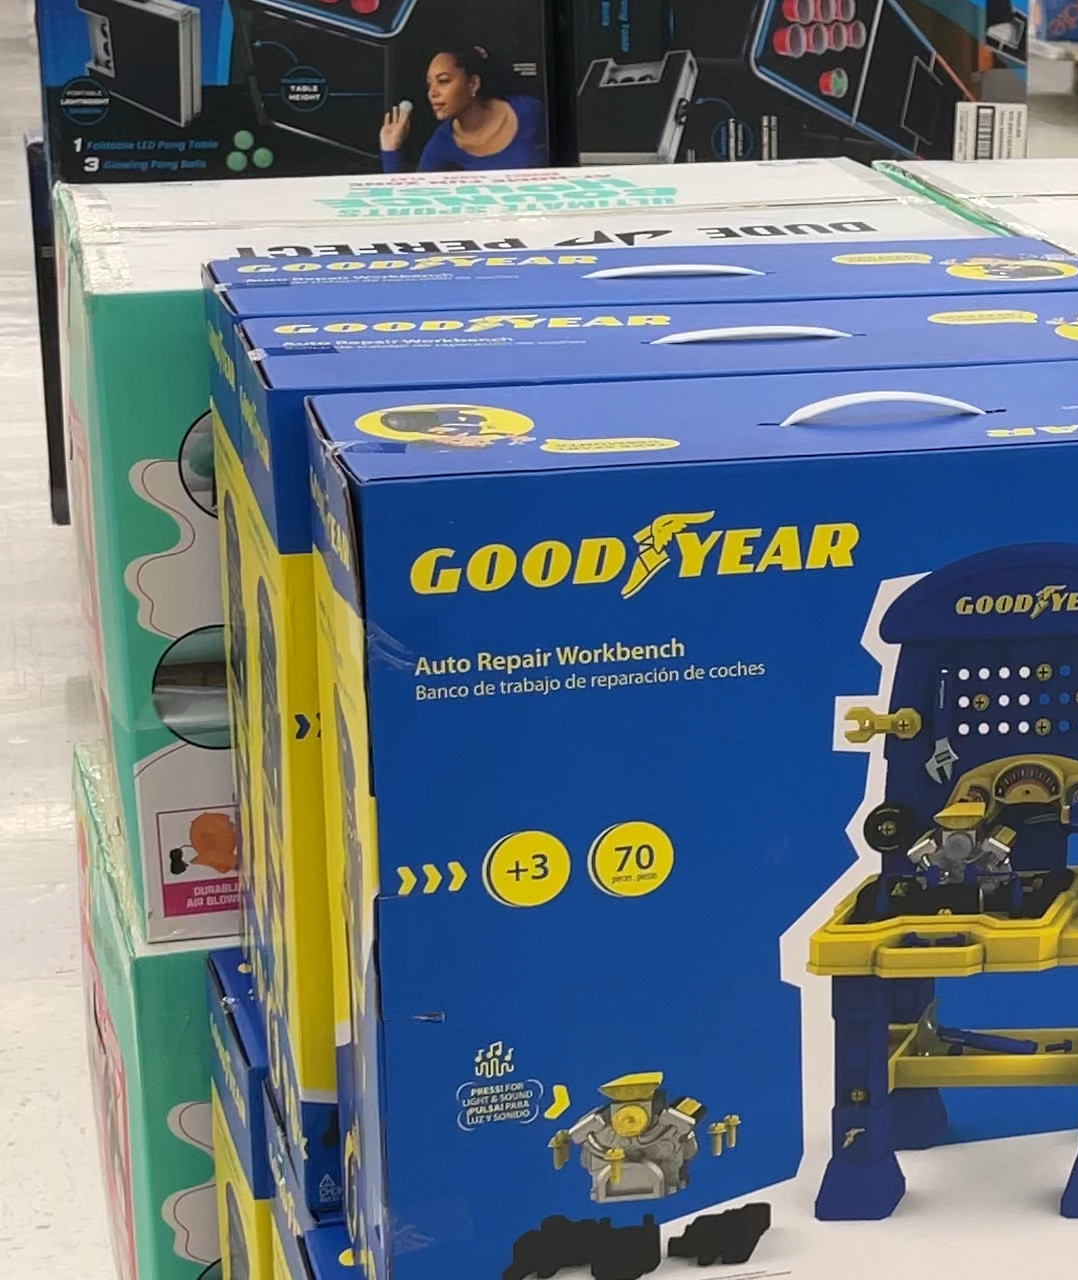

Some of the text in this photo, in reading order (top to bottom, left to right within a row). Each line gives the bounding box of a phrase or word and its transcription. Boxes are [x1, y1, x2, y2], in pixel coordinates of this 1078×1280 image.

[73, 138, 83, 153] 1
[84, 157, 100, 172] 3
[697, 221, 878, 240] DUDE
[237, 254, 598, 274] GOODYEAR
[273, 314, 671, 335] GOODYEAR
[409, 511, 860, 599] GOODYEAR
[415, 637, 686, 677] Auto Repair Workbench
[416, 660, 766, 701] Banco de trabajo de reparación de coches
[506, 854, 550, 882] +3
[614, 844, 655, 873] 70
